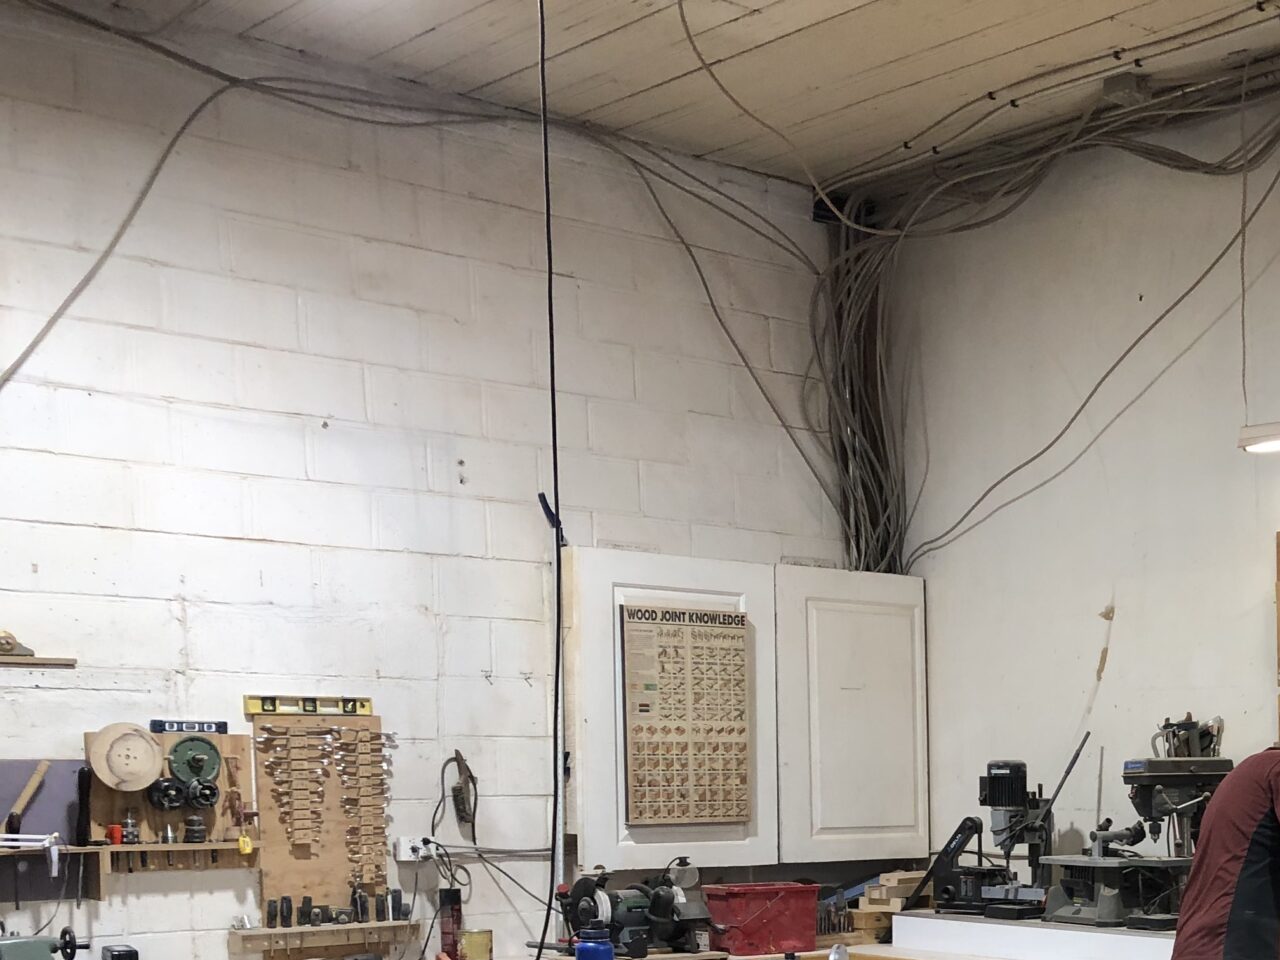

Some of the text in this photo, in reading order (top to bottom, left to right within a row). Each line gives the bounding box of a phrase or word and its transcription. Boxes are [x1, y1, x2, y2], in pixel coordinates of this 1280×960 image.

[627, 608, 745, 626] WOOD JOINT KNOWLEDGE
